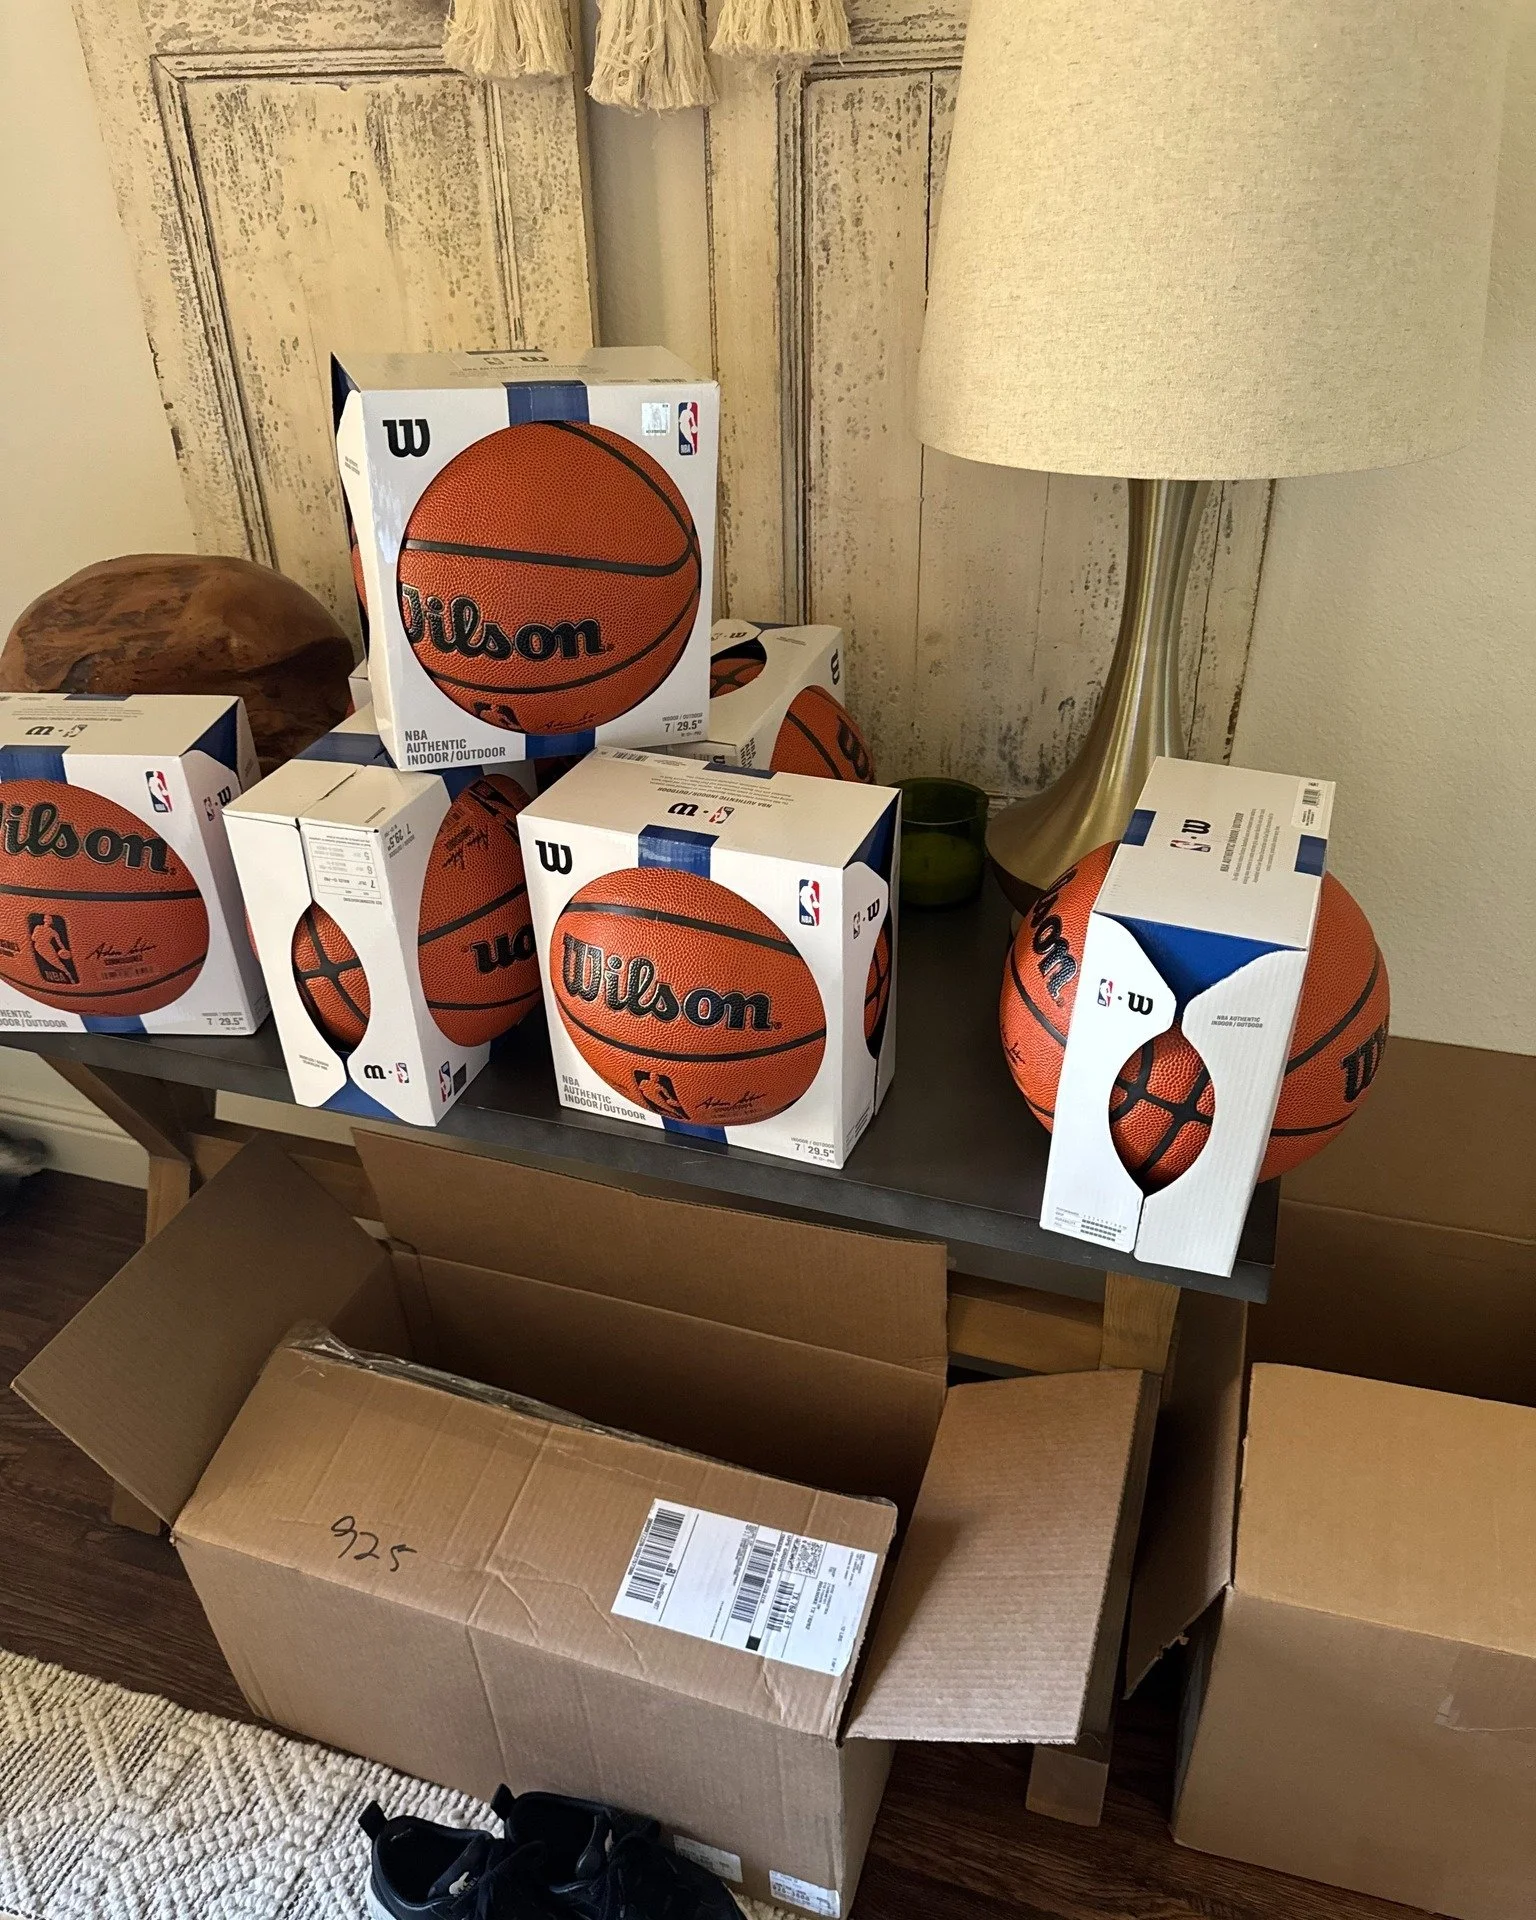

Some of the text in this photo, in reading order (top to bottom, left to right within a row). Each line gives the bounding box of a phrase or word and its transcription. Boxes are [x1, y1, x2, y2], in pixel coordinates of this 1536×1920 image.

[664, 720, 703, 732] 7 29.5"
[405, 730, 428, 741] NBA
[406, 738, 467, 753] AUTHENTIC
[407, 746, 506, 765] INDOOR/OUTDOOR
[0, 801, 170, 874] ilson
[45, 970, 66, 982] NBA
[563, 931, 774, 1032] Wilson
[562, 1074, 580, 1087] NBA
[564, 1085, 612, 1104] AUTHENTIC
[564, 1093, 646, 1120] INDOOR/OUTDOOR
[795, 1143, 834, 1157] 7 29.5"
[331, 1515, 417, 1572] 925
[791, 1591, 800, 1601] TX
